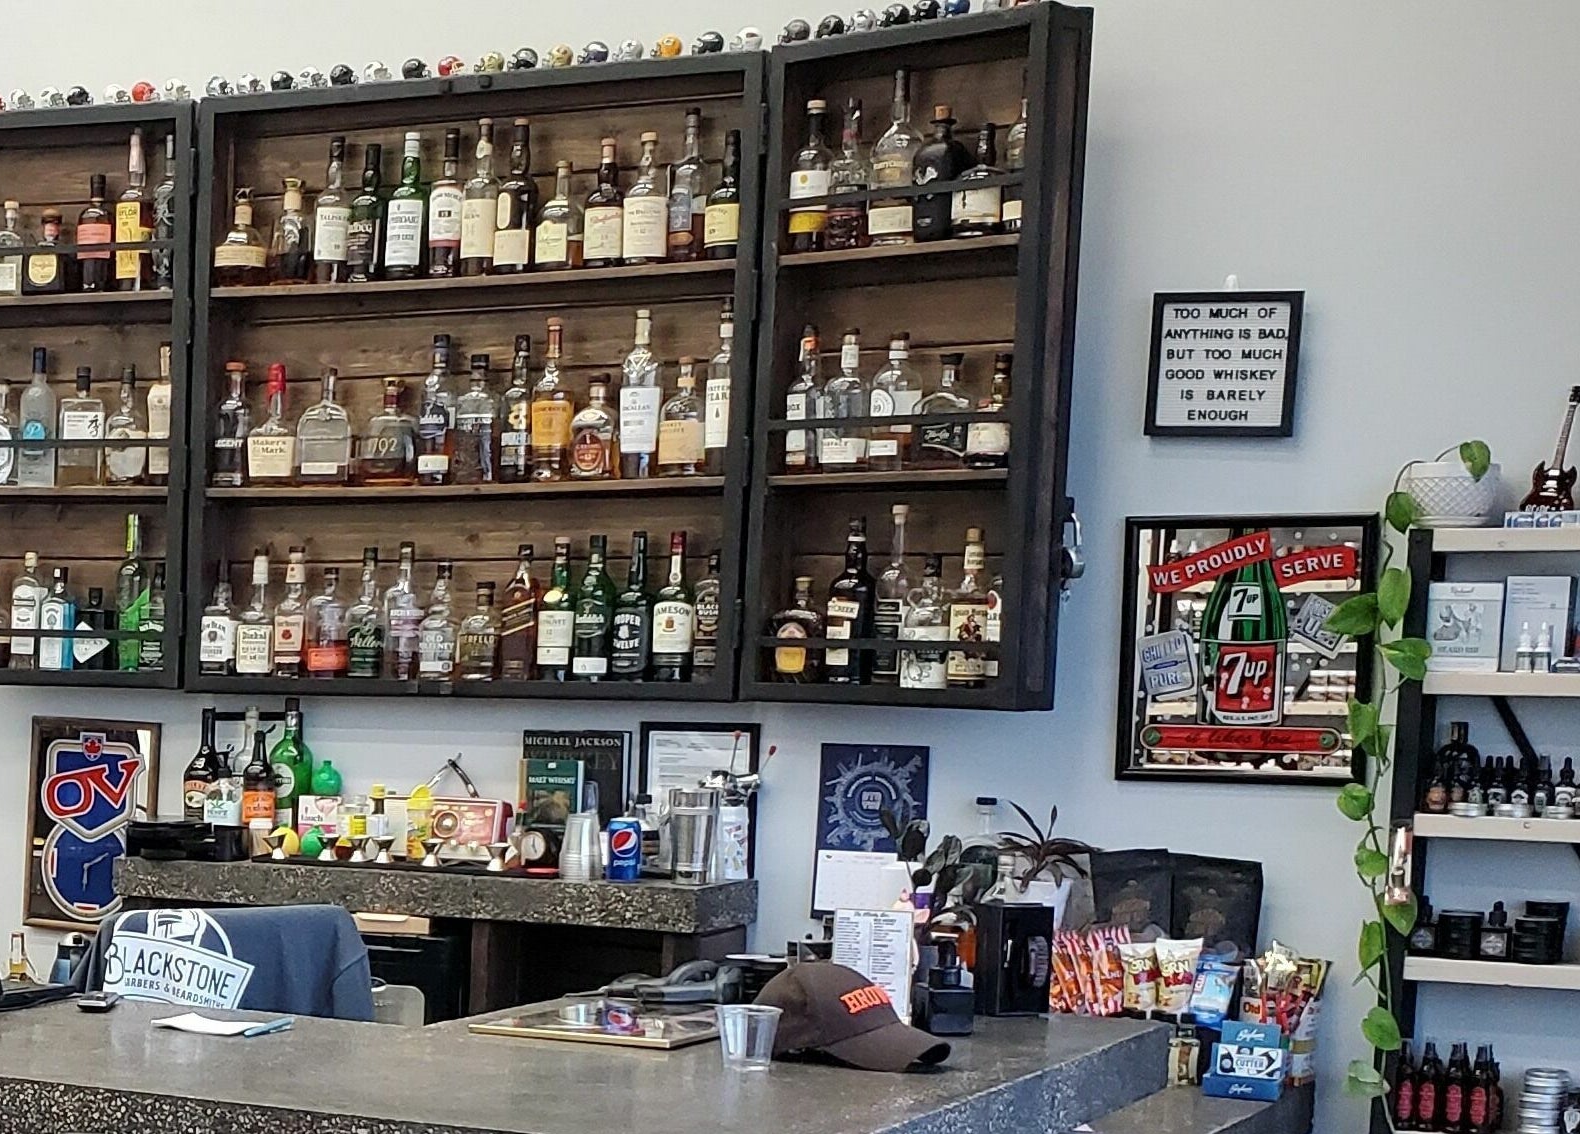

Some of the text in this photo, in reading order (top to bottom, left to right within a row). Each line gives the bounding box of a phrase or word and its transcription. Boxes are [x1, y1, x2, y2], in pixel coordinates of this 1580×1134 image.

[1173, 307, 1277, 319] TOO MUCH OF
[1164, 328, 1234, 339] ANYTHING
[1238, 328, 1251, 339] IS
[1166, 349, 1282, 360] BUT TOO MUCH
[1165, 369, 1277, 380] GOOD WHISKEY
[1180, 389, 1266, 401] IS BARELY
[1187, 410, 1249, 421] ENOUGH
[1153, 538, 1344, 587] WE PROUDLY SERVE
[655, 605, 691, 617] JAMESON
[524, 736, 621, 748] MICHAEL JACKSON
[103, 942, 236, 1000] BLACKSTONE
[163, 983, 170, 993] &
